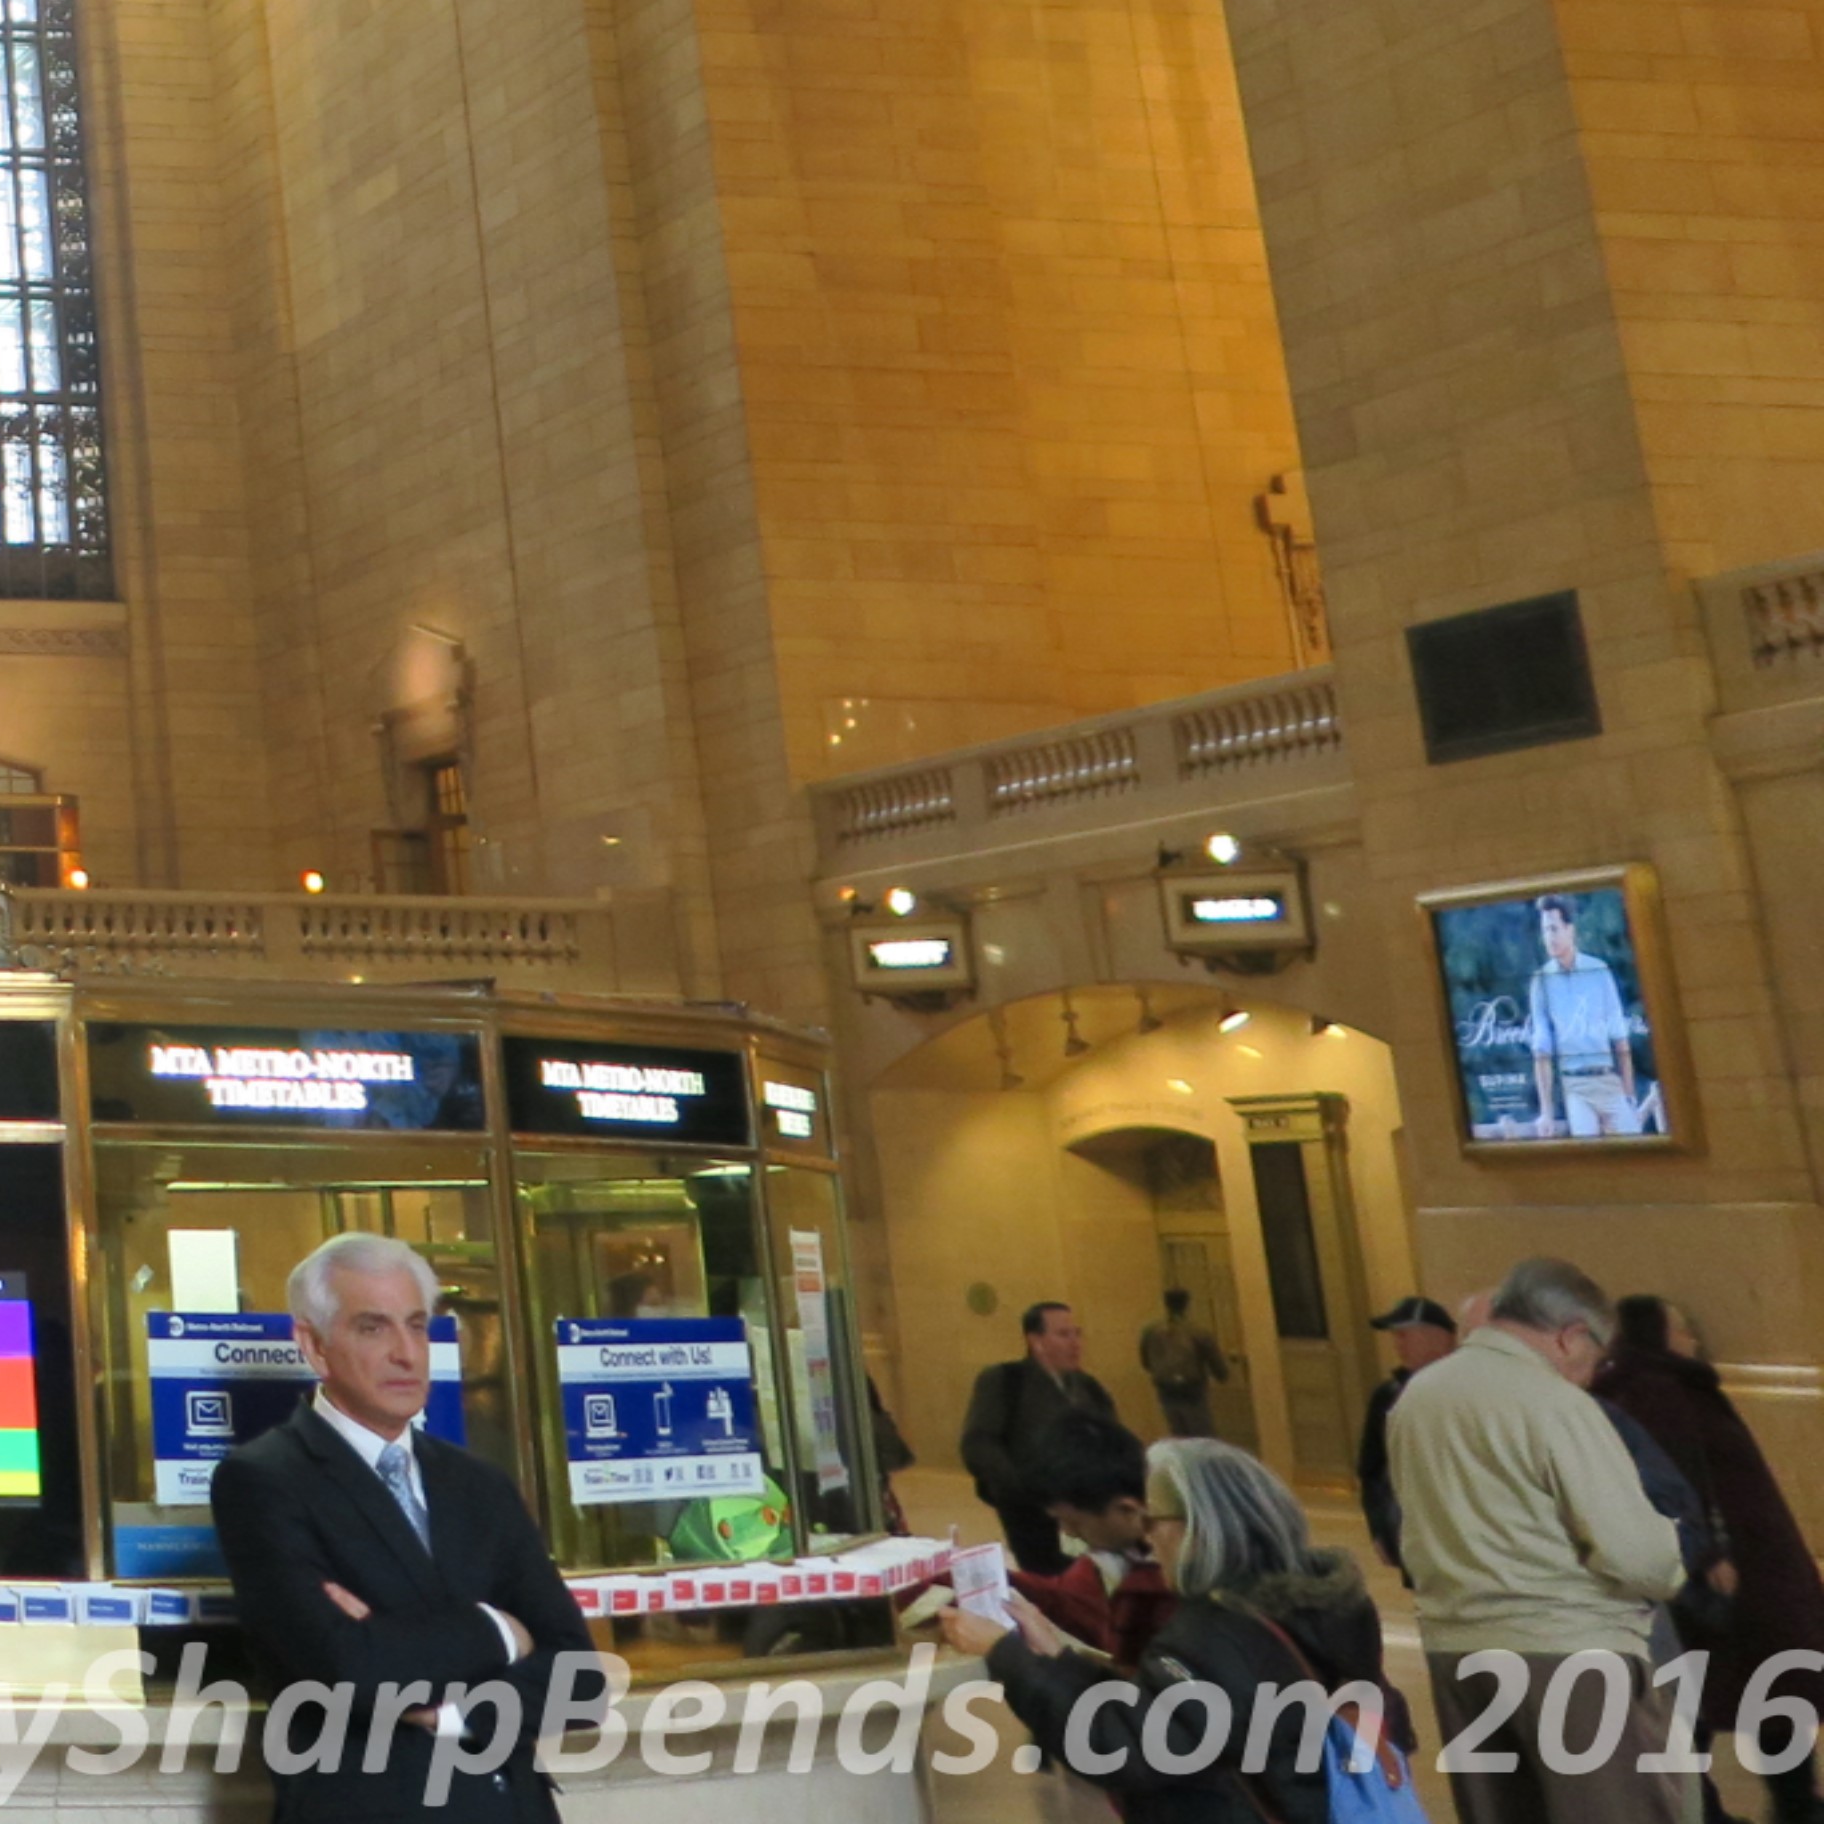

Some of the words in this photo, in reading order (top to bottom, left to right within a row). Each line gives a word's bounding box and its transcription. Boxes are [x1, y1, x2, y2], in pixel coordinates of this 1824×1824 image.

[149, 1045, 213, 1075] MTA
[214, 1047, 415, 1081] METRO-NORTH
[205, 1078, 368, 1110] TIMETABLES
[214, 1342, 306, 1365] Connect
[599, 1347, 657, 1368] Connect
[659, 1345, 689, 1366] with
[690, 1345, 713, 1365] Us!
